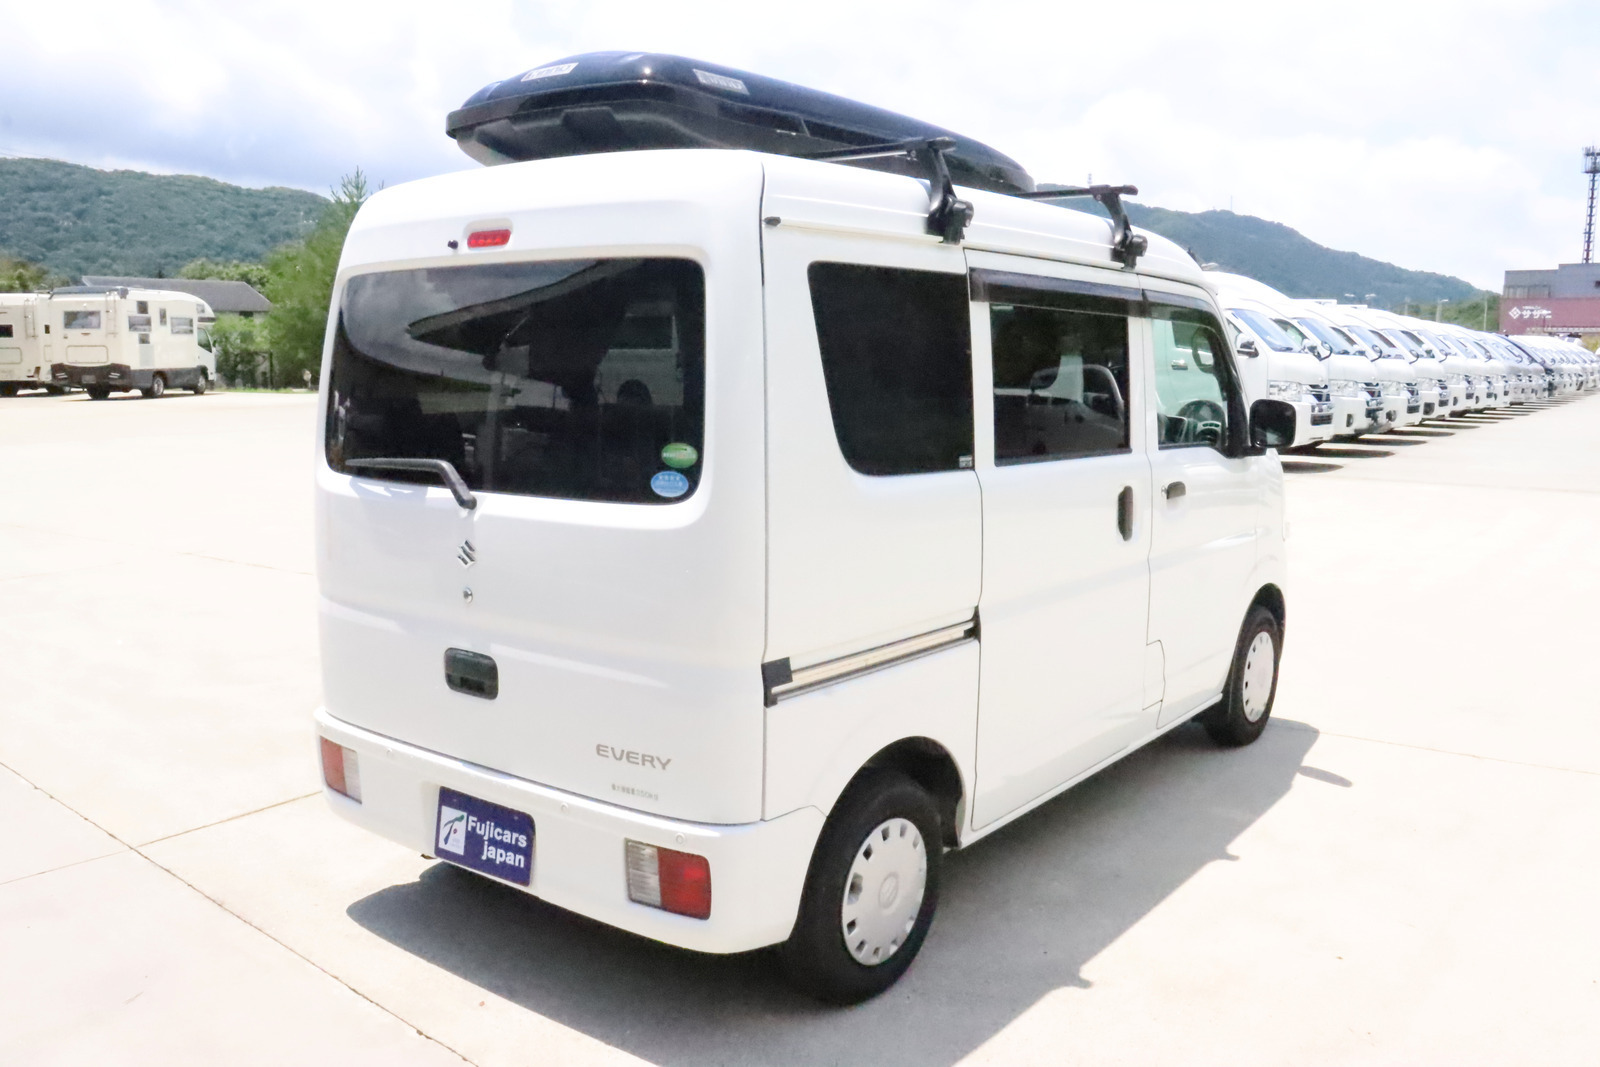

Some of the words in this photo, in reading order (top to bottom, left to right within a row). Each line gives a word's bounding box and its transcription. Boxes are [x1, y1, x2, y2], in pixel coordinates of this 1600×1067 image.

[595, 743, 672, 771] EVERY
[467, 815, 527, 848] Fujicars
[481, 840, 525, 869] japan
